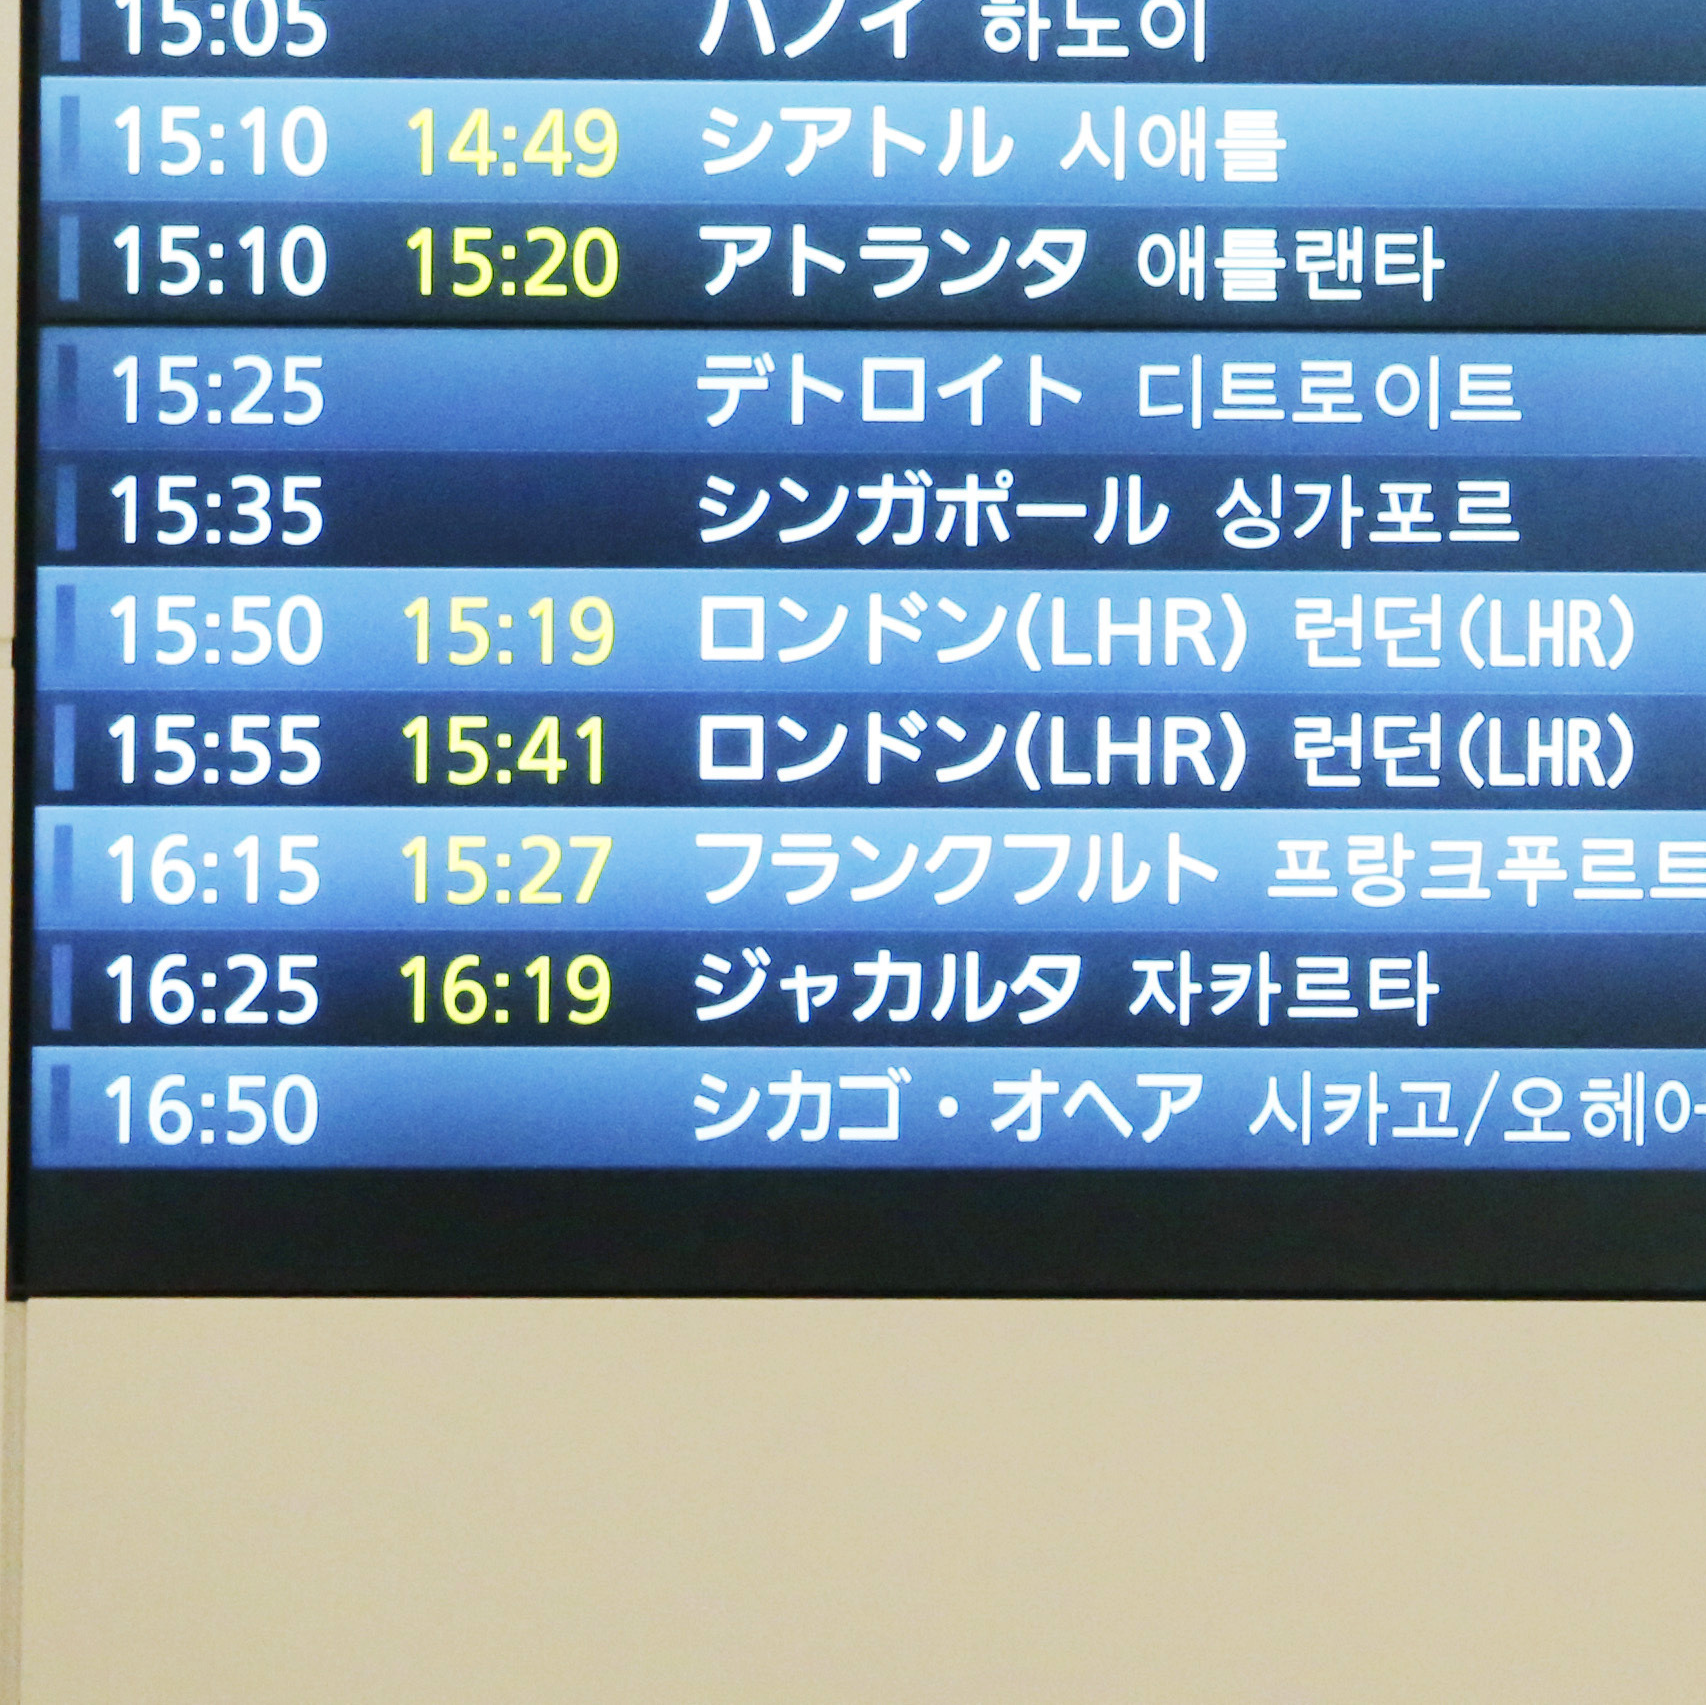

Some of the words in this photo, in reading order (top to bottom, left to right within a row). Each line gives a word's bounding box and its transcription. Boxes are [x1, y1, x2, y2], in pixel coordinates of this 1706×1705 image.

[115, 105, 328, 177] 15:10
[408, 107, 618, 178] 14:49
[702, 105, 1014, 178] シアトル
[1060, 105, 1287, 182] 시애틀
[114, 225, 326, 296] 15:10
[407, 227, 618, 298] 15:20
[699, 224, 1086, 299] アトランタ
[1138, 225, 1445, 301] 애틀랜타
[113, 355, 323, 425] 15:25
[697, 352, 1082, 427] デトロイト
[1139, 354, 1522, 430] 디트로이트
[112, 475, 322, 545] 15:35
[699, 469, 1169, 546] シンガポール
[1216, 474, 1520, 549] 싱가포르
[110, 595, 323, 665] 15:50
[404, 596, 614, 666] 15:19
[700, 591, 1247, 672] ロンドン(LHR)
[1295, 593, 1634, 670] 런던(LHR)
[109, 715, 321, 785] 15:55
[403, 716, 602, 785] 15:41
[699, 710, 1246, 791] ロンドン(LHR)
[1294, 712, 1634, 789] 런던(LHR)
[108, 833, 320, 905] 16:15
[402, 834, 612, 905] 15:27
[695, 832, 1219, 905] フランクフルト
[107, 954, 318, 1024] 16:25
[401, 954, 610, 1024] 16:19
[695, 947, 1081, 1024] ジャカルタ
[1129, 950, 1440, 1026] 자카르타
[106, 1074, 318, 1145] 16:50
[694, 1067, 1203, 1143] シカゴ・オヘア
